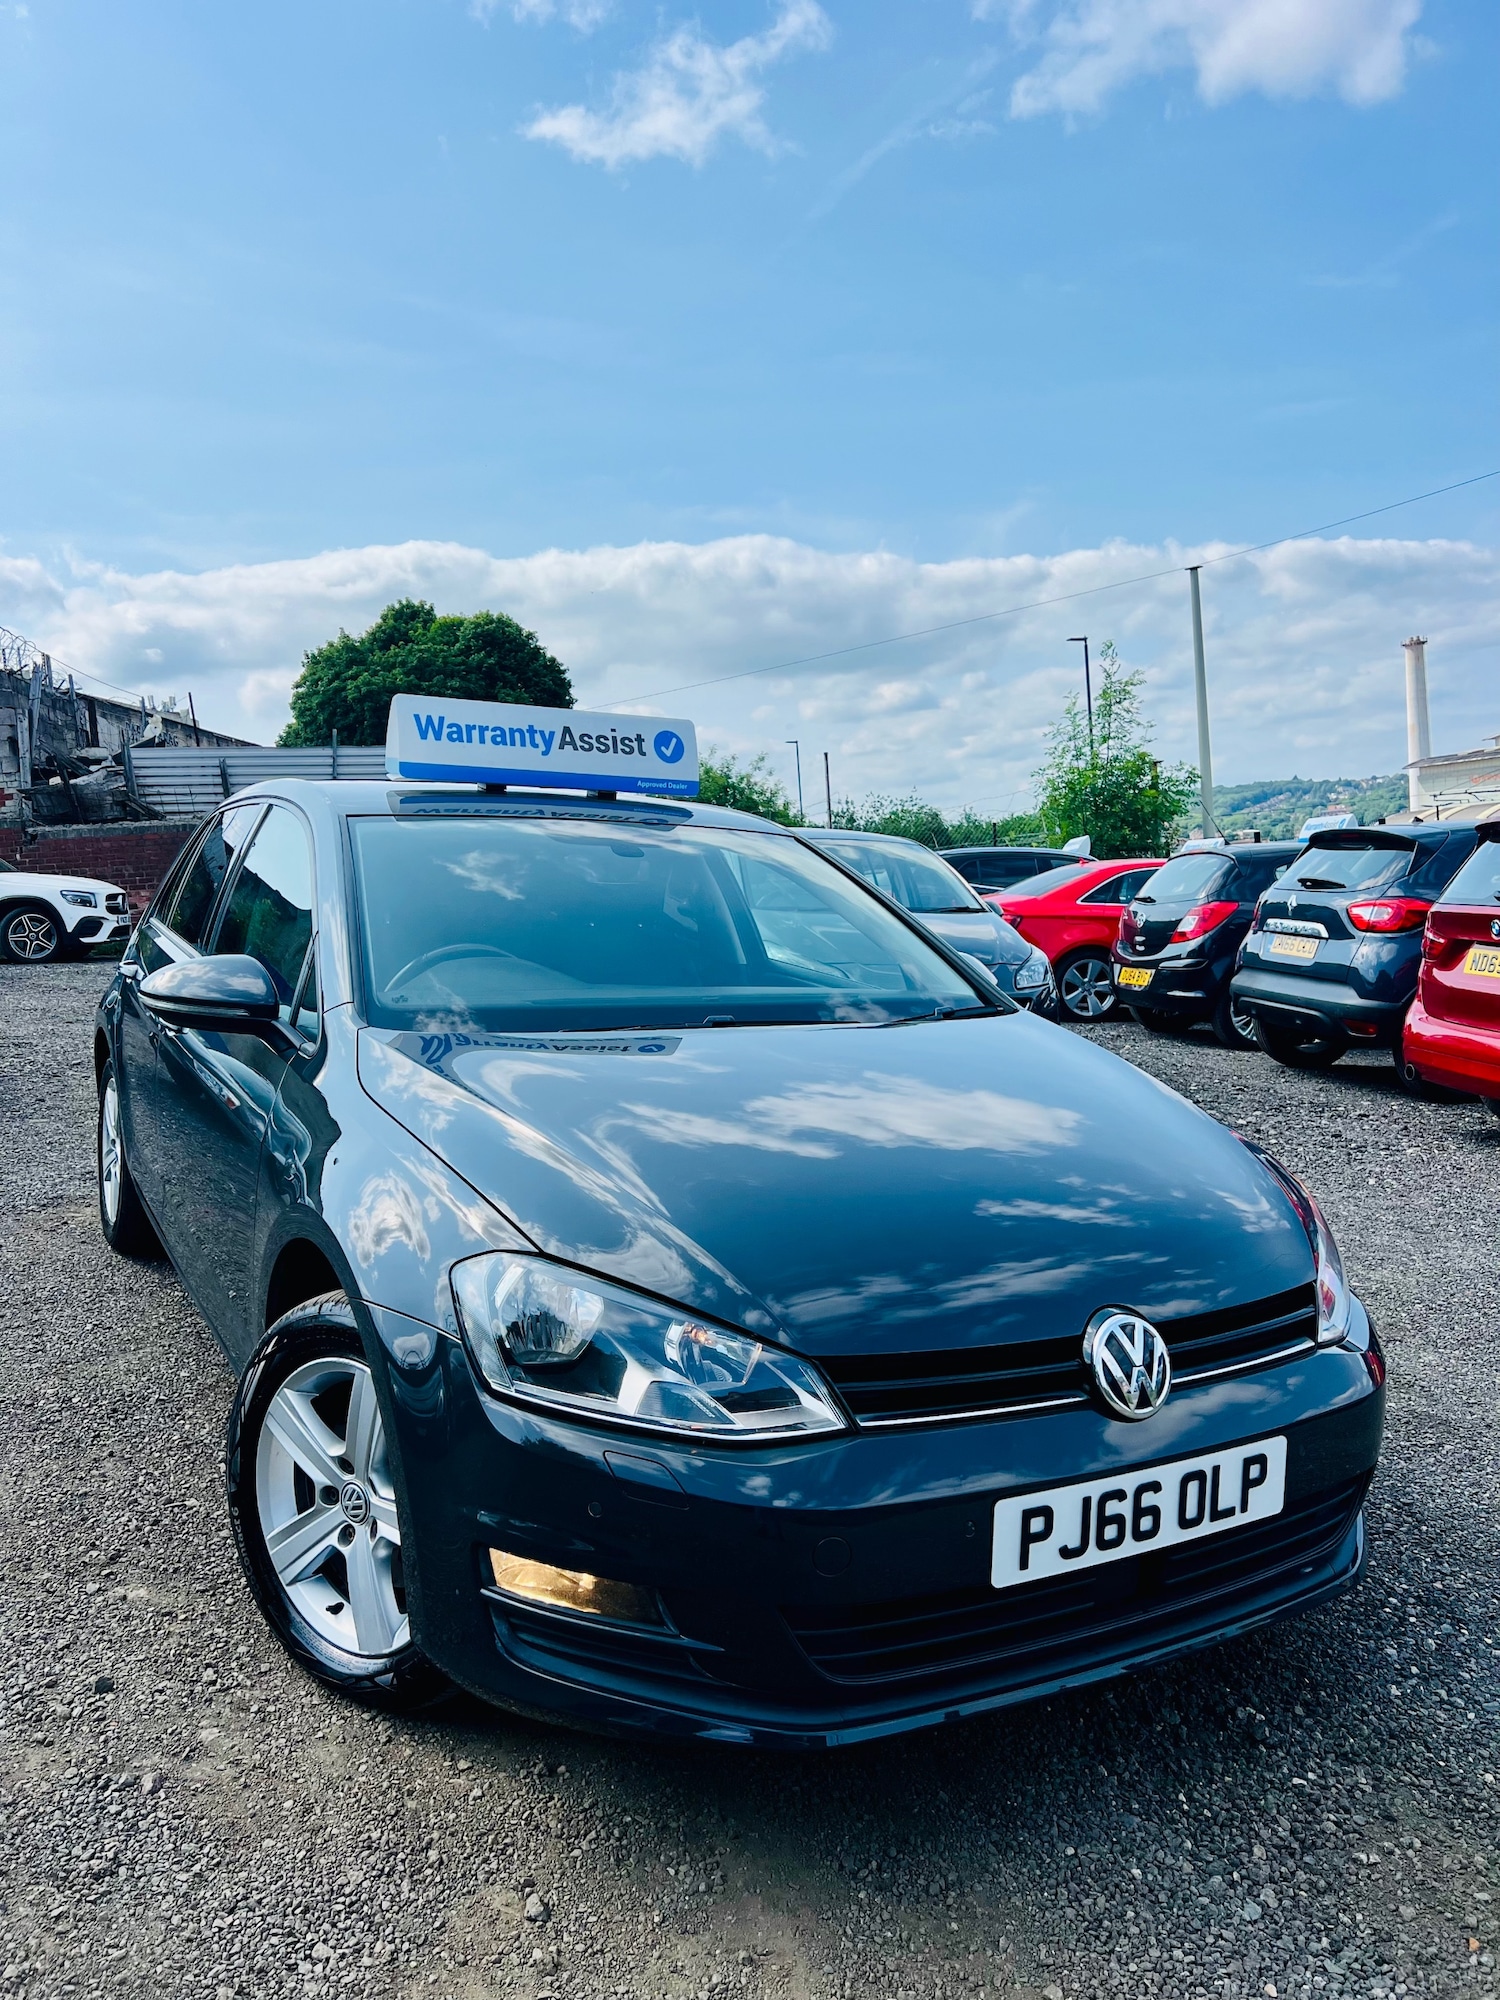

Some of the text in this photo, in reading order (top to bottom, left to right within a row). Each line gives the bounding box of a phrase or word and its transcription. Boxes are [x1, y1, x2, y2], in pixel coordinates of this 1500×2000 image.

[637, 780, 688, 790] Approved Dealer
[1019, 1453, 1268, 1572] PJ66 OLP
